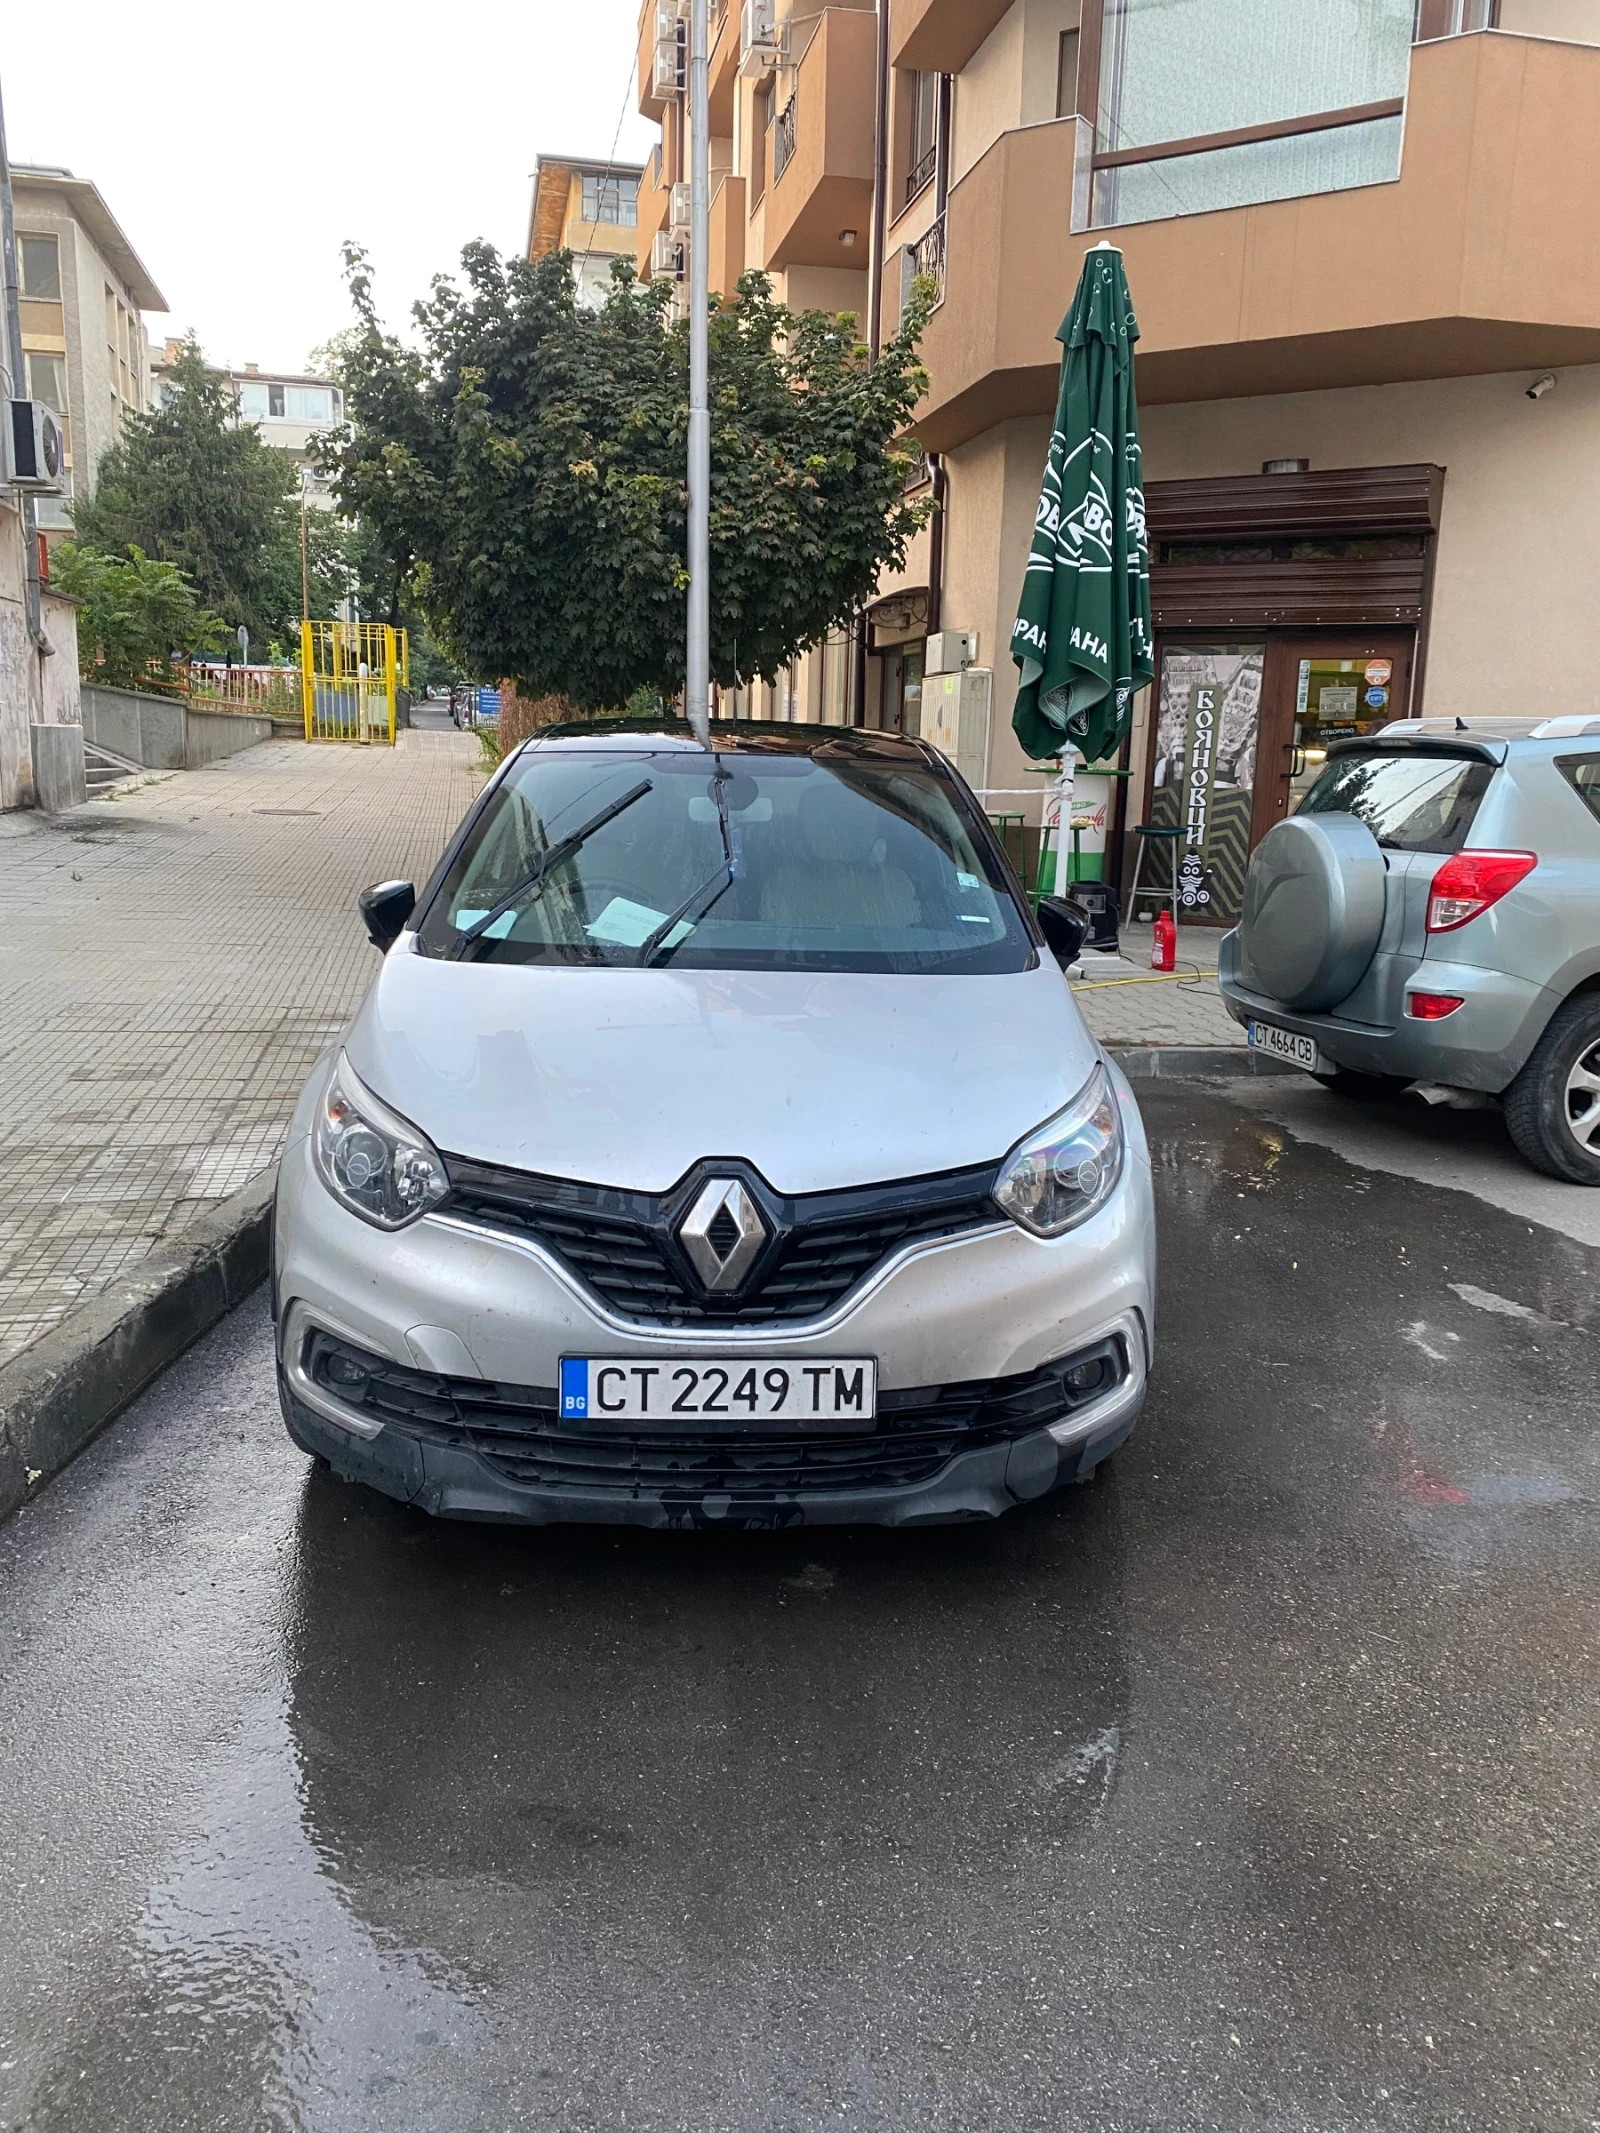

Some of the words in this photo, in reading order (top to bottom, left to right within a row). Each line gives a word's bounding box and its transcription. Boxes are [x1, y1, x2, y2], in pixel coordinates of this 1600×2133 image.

[1320, 727, 1355, 736] ОТВОРЕНО
[1186, 690, 1214, 845] БОЯНОВЦИ
[1255, 1024, 1268, 1046] CT
[1270, 1030, 1296, 1056] 4664
[1298, 1038, 1312, 1061] CB
[565, 1396, 585, 1410] BG
[597, 1367, 659, 1411] CT
[672, 1367, 790, 1412] 2249
[802, 1366, 863, 1411] TM
